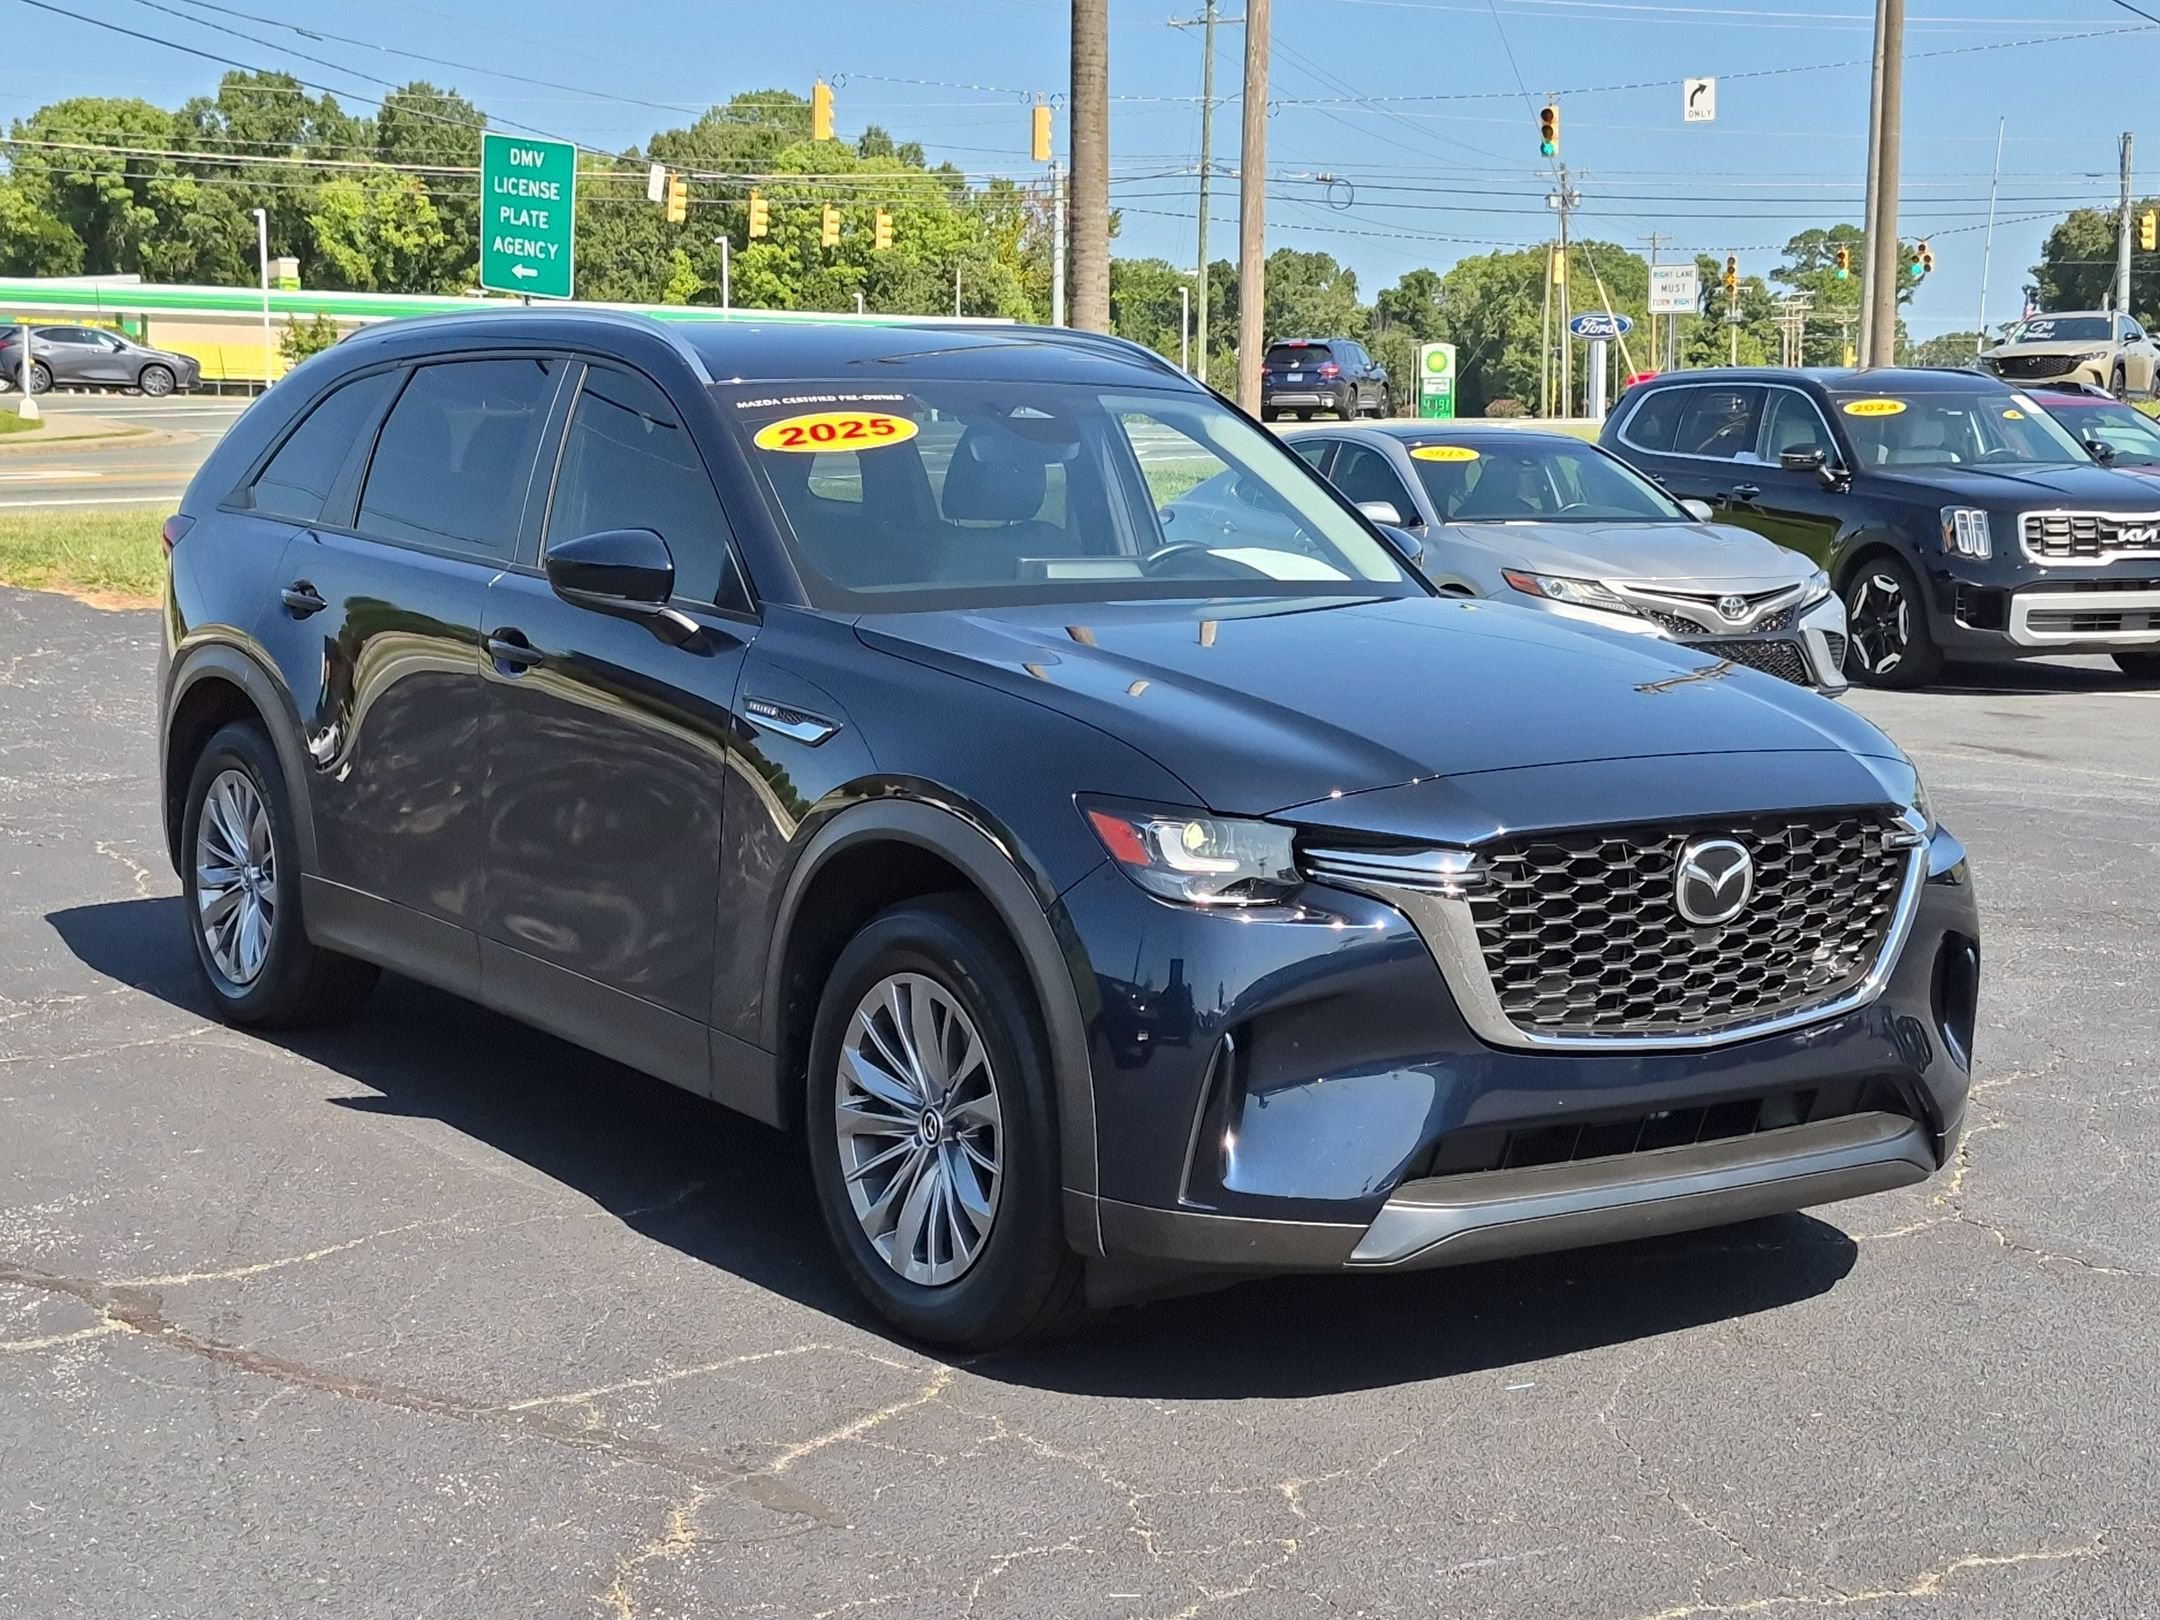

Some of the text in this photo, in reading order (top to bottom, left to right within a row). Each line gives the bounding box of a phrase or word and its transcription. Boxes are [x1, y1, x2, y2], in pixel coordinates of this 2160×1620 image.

[1688, 109, 1712, 118] ONLY
[510, 148, 545, 168] DMV
[494, 175, 560, 200] LICENSE
[500, 206, 549, 229] PLATE
[493, 235, 559, 260] AGENCY
[1675, 269, 1695, 278] LANE
[1660, 283, 1686, 293] MUST
[736, 393, 904, 409] MAZDA CERTIFIED PRE-OWNED
[1852, 404, 1898, 413] 2024
[778, 418, 896, 447] 2025
[2117, 528, 2158, 542] KIA
